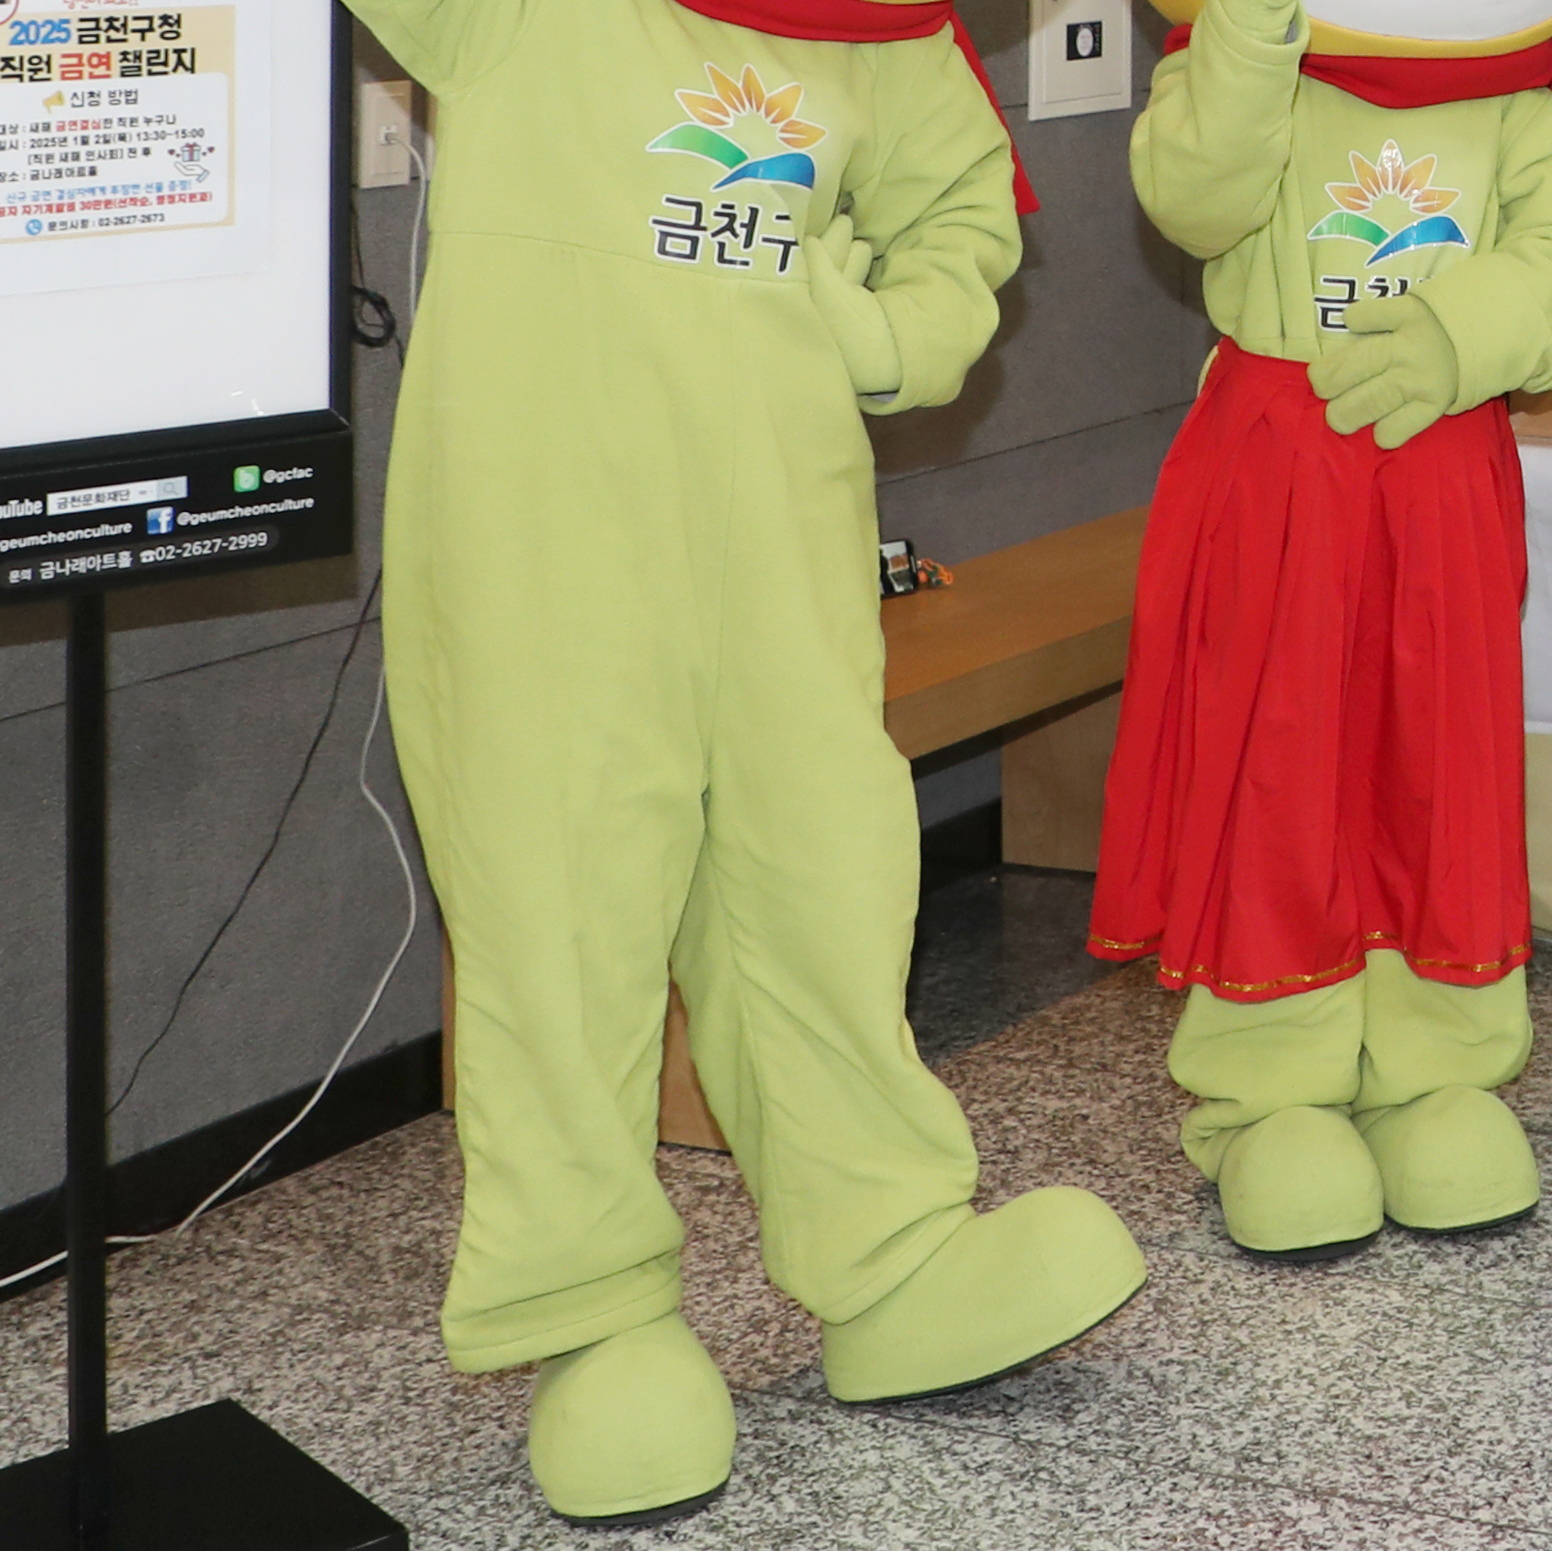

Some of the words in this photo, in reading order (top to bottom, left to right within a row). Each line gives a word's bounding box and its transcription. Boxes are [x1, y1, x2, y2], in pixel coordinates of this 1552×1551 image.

[9, 18, 72, 45] 2025
[77, 14, 182, 44] 금천구청
[0, 53, 53, 83] 직원
[58, 51, 112, 81] 금연
[118, 47, 196, 78] 챌린지
[70, 90, 102, 108] 신청
[108, 89, 139, 105] 방법
[143, 114, 177, 127] 누구나
[650, 195, 801, 274] 금천구
[263, 466, 313, 484] @gcfac
[56, 488, 131, 511] 금천문화재단
[177, 496, 315, 527] @geumcheonculture
[40, 549, 132, 580] 금나래아트홀
[154, 532, 268, 563] 02-2627-2999
